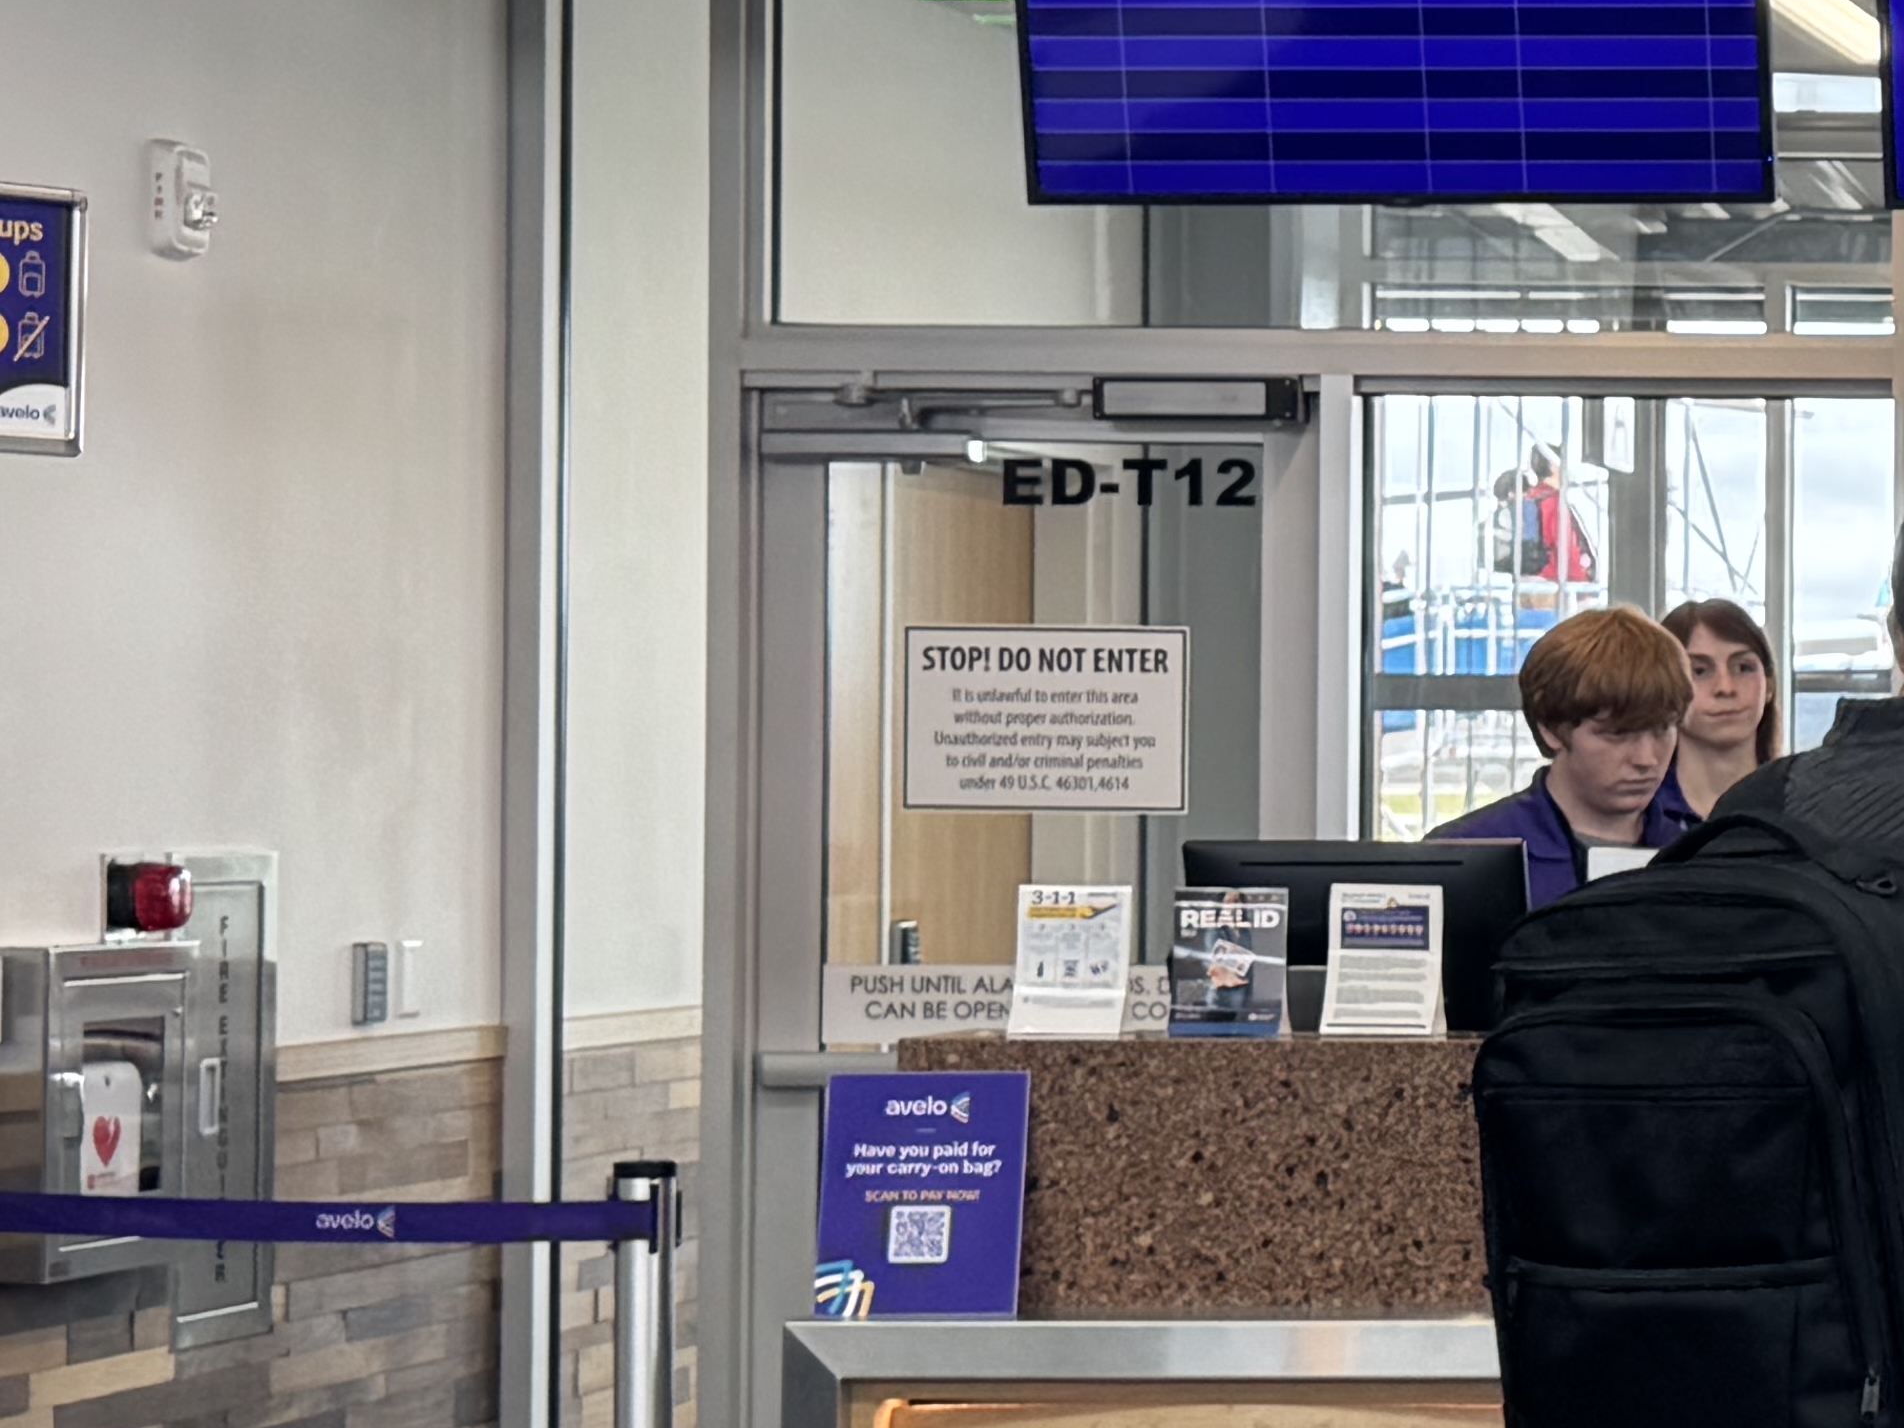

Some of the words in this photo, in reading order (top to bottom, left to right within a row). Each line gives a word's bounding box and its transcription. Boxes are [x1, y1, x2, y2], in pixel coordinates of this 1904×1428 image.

[1001, 456, 1258, 509] ED-T12
[922, 646, 991, 672] STOP!
[998, 647, 1031, 672] DO
[1038, 648, 1087, 673] NOT
[1093, 648, 1169, 674] ENTER
[977, 688, 1031, 703] unlawful
[1035, 689, 1048, 703] to
[1050, 691, 1083, 703] enter
[1086, 689, 1108, 704] this
[1111, 692, 1138, 704] area
[953, 710, 1003, 724] without
[1006, 713, 1046, 728] proper
[933, 731, 1018, 746] Unauthorized
[1020, 734, 1053, 750] entry
[1056, 735, 1084, 750] may
[1086, 732, 1129, 750] subject
[1133, 735, 1156, 750] you
[945, 755, 959, 768] to
[961, 753, 986, 768] civil
[989, 753, 1031, 770] and/or
[1034, 754, 1084, 769] criminal
[1087, 754, 1143, 772] penalties
[959, 775, 997, 791] under
[999, 776, 1015, 790] 49
[1055, 776, 1130, 793] 46301,4614
[1031, 890, 1077, 906] 3-1-1
[1180, 908, 1250, 929] REAL
[1254, 909, 1281, 929] ID
[850, 975, 904, 994] PUSH
[910, 975, 966, 994] UNTIL
[865, 1001, 918, 1020] CAN
[923, 1002, 948, 1020] BE
[885, 1095, 948, 1116] avelo
[854, 1143, 896, 1158] Have
[899, 1145, 930, 1161] you
[933, 1140, 969, 1159] paid
[972, 1140, 996, 1158] for
[845, 1161, 884, 1178] your
[886, 1162, 959, 1178] carry-on
[962, 1159, 1002, 1177] bag?
[865, 1189, 899, 1203] SCAN
[902, 1190, 917, 1202] TO
[315, 1209, 375, 1230] avelo
